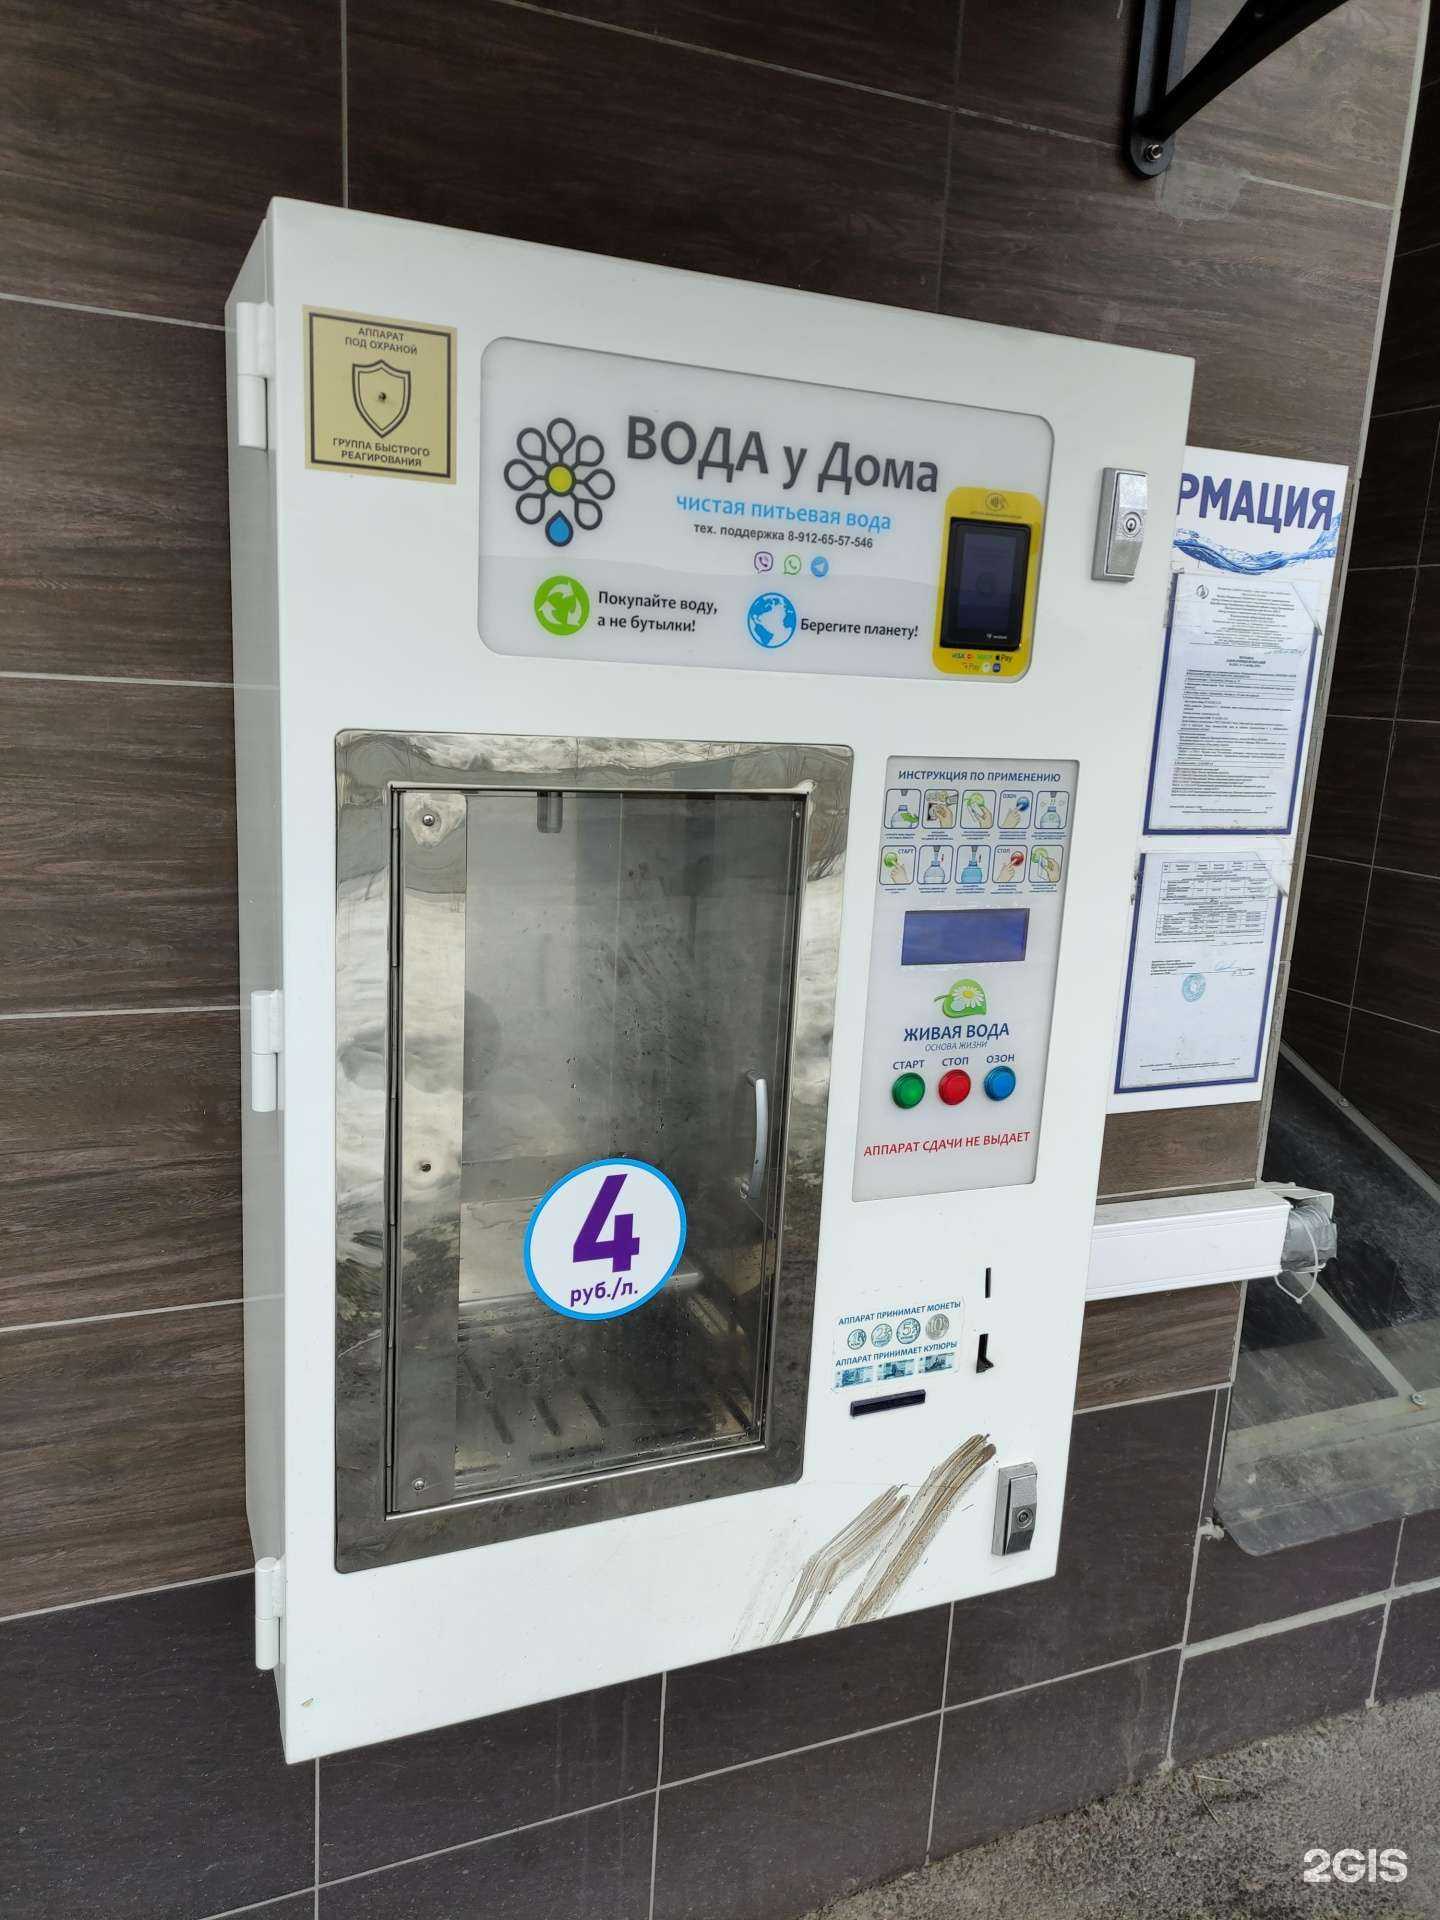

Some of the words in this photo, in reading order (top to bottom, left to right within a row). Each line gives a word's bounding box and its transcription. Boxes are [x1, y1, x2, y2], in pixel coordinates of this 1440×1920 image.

[358, 327, 404, 341] АППАРАТ
[345, 337, 367, 349] ПОД
[370, 341, 418, 355] ОХРАНОЙ
[333, 437, 372, 451] ГРУППА
[375, 443, 430, 457] БЫСТРОГО
[626, 415, 769, 483] ВОДА
[783, 445, 808, 490] у
[817, 440, 939, 496] Дома
[341, 450, 422, 467] РЕАГИРОВАНИЯ
[676, 495, 745, 516] чистая
[751, 502, 840, 525] питьевая
[846, 511, 892, 534] вода
[694, 523, 716, 535] тех.
[720, 526, 785, 543] поддержка
[787, 531, 873, 549] 8-912-65-57-546
[598, 591, 677, 610] Покупайте
[680, 599, 718, 615] воду,
[597, 616, 605, 627] а
[610, 617, 627, 628] не
[630, 615, 696, 632] бутылки!
[800, 618, 861, 635] Берегите
[864, 625, 919, 640] планету!
[898, 770, 967, 782] ИНСТРУКЦИЯ
[970, 772, 985, 781] ПО
[988, 772, 1061, 783] ПРИМЕНЕНИЮ
[904, 1025, 962, 1041] ЖИВАЯ
[966, 1022, 1010, 1040] ВОДА
[925, 1042, 957, 1052] ОСНОВА
[959, 1040, 988, 1049] ЖИЗНИ
[892, 1059, 925, 1070] СТАРТ
[941, 1056, 969, 1067] СТОП
[986, 1054, 1015, 1064] ОЗОН
[863, 1141, 921, 1157] АППАРАТ
[922, 1137, 962, 1154] СДАЧИ
[966, 1136, 980, 1147] НЕ
[983, 1131, 1031, 1146] ВЫДАЕТ
[572, 1173, 640, 1273] 4
[570, 1277, 638, 1307] руб./л.
[838, 1313, 876, 1325] АППАРАТ
[876, 1305, 926, 1319] ПРИНИМАЕТ
[927, 1301, 961, 1312] МОНЕТЫ
[836, 1354, 872, 1367] АППАРАТ
[874, 1346, 922, 1360] ПРИНИМАЕТ
[924, 1341, 959, 1352] КУПЮРЫ
